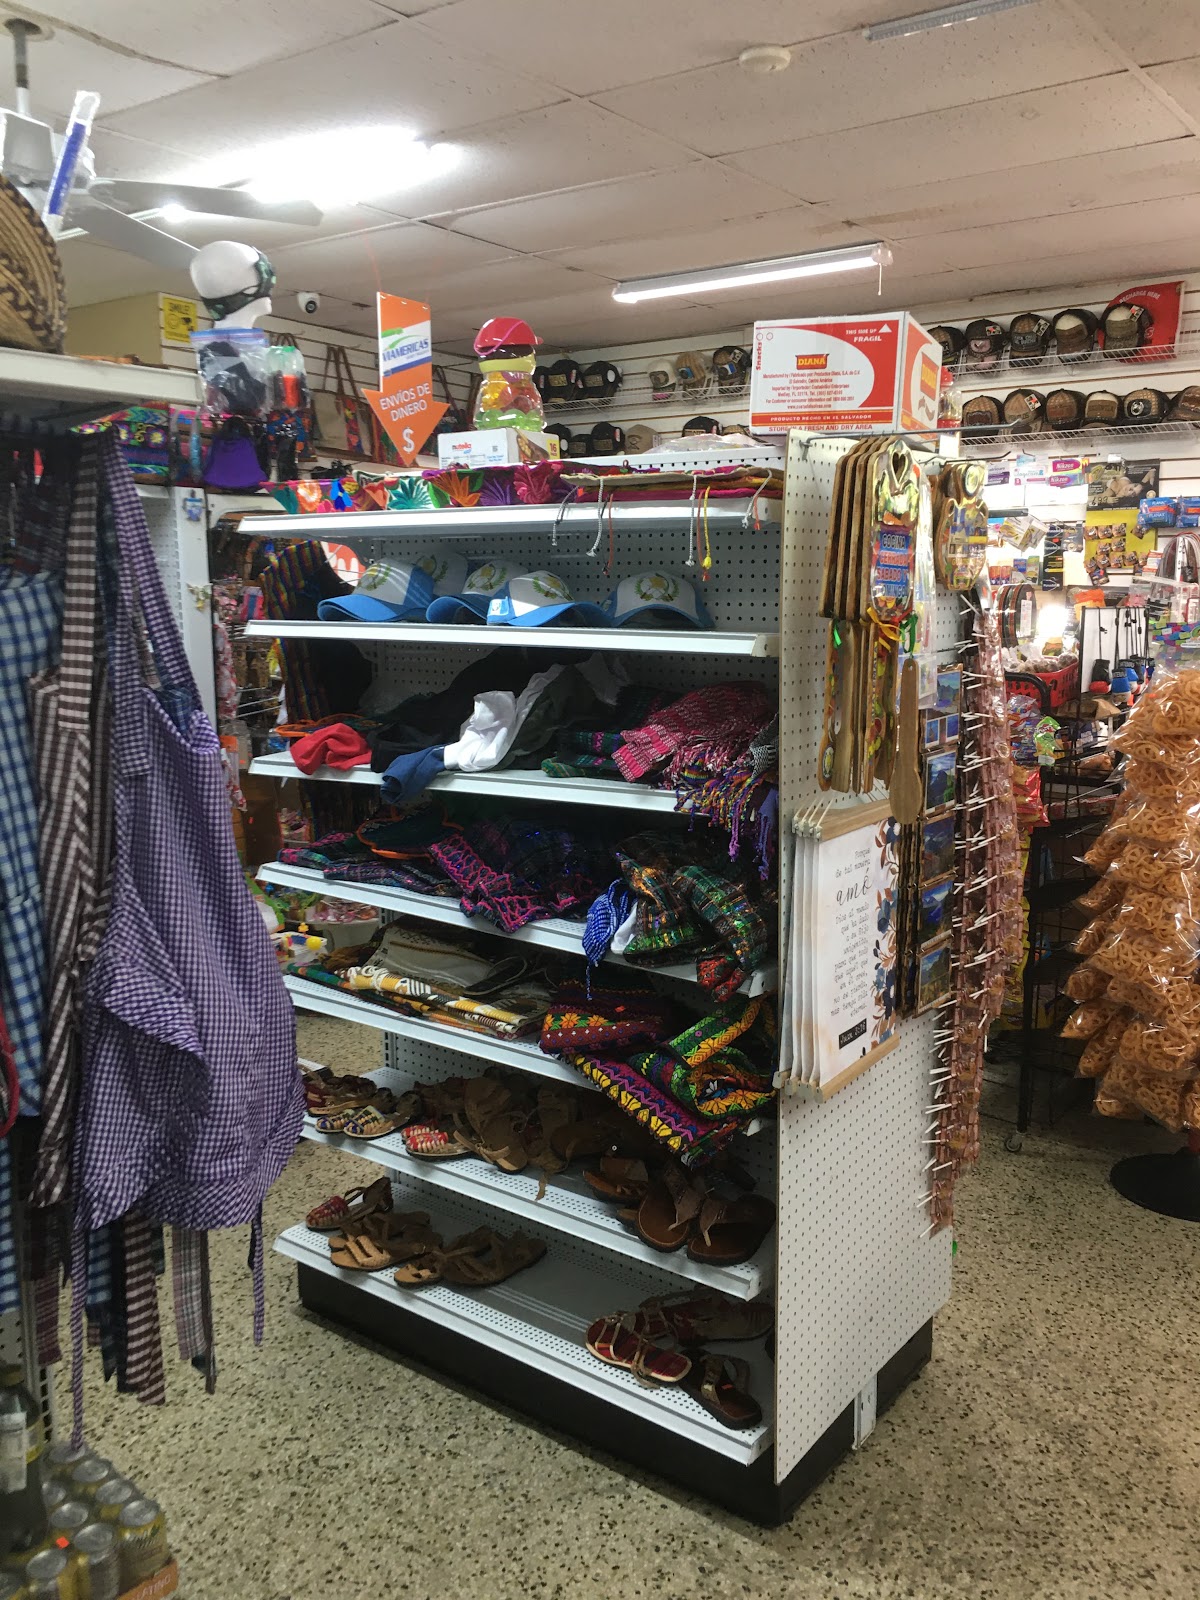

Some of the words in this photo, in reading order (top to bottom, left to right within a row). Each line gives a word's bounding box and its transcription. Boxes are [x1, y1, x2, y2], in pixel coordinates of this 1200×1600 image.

[798, 357, 826, 366] DIANA
[416, 382, 431, 397] DE
[390, 399, 427, 422] DINERO
[402, 426, 415, 454] $
[452, 442, 472, 450] nutella
[549, 443, 557, 453] 16
[882, 533, 906, 549] COCINA
[876, 567, 901, 582] SABADO
